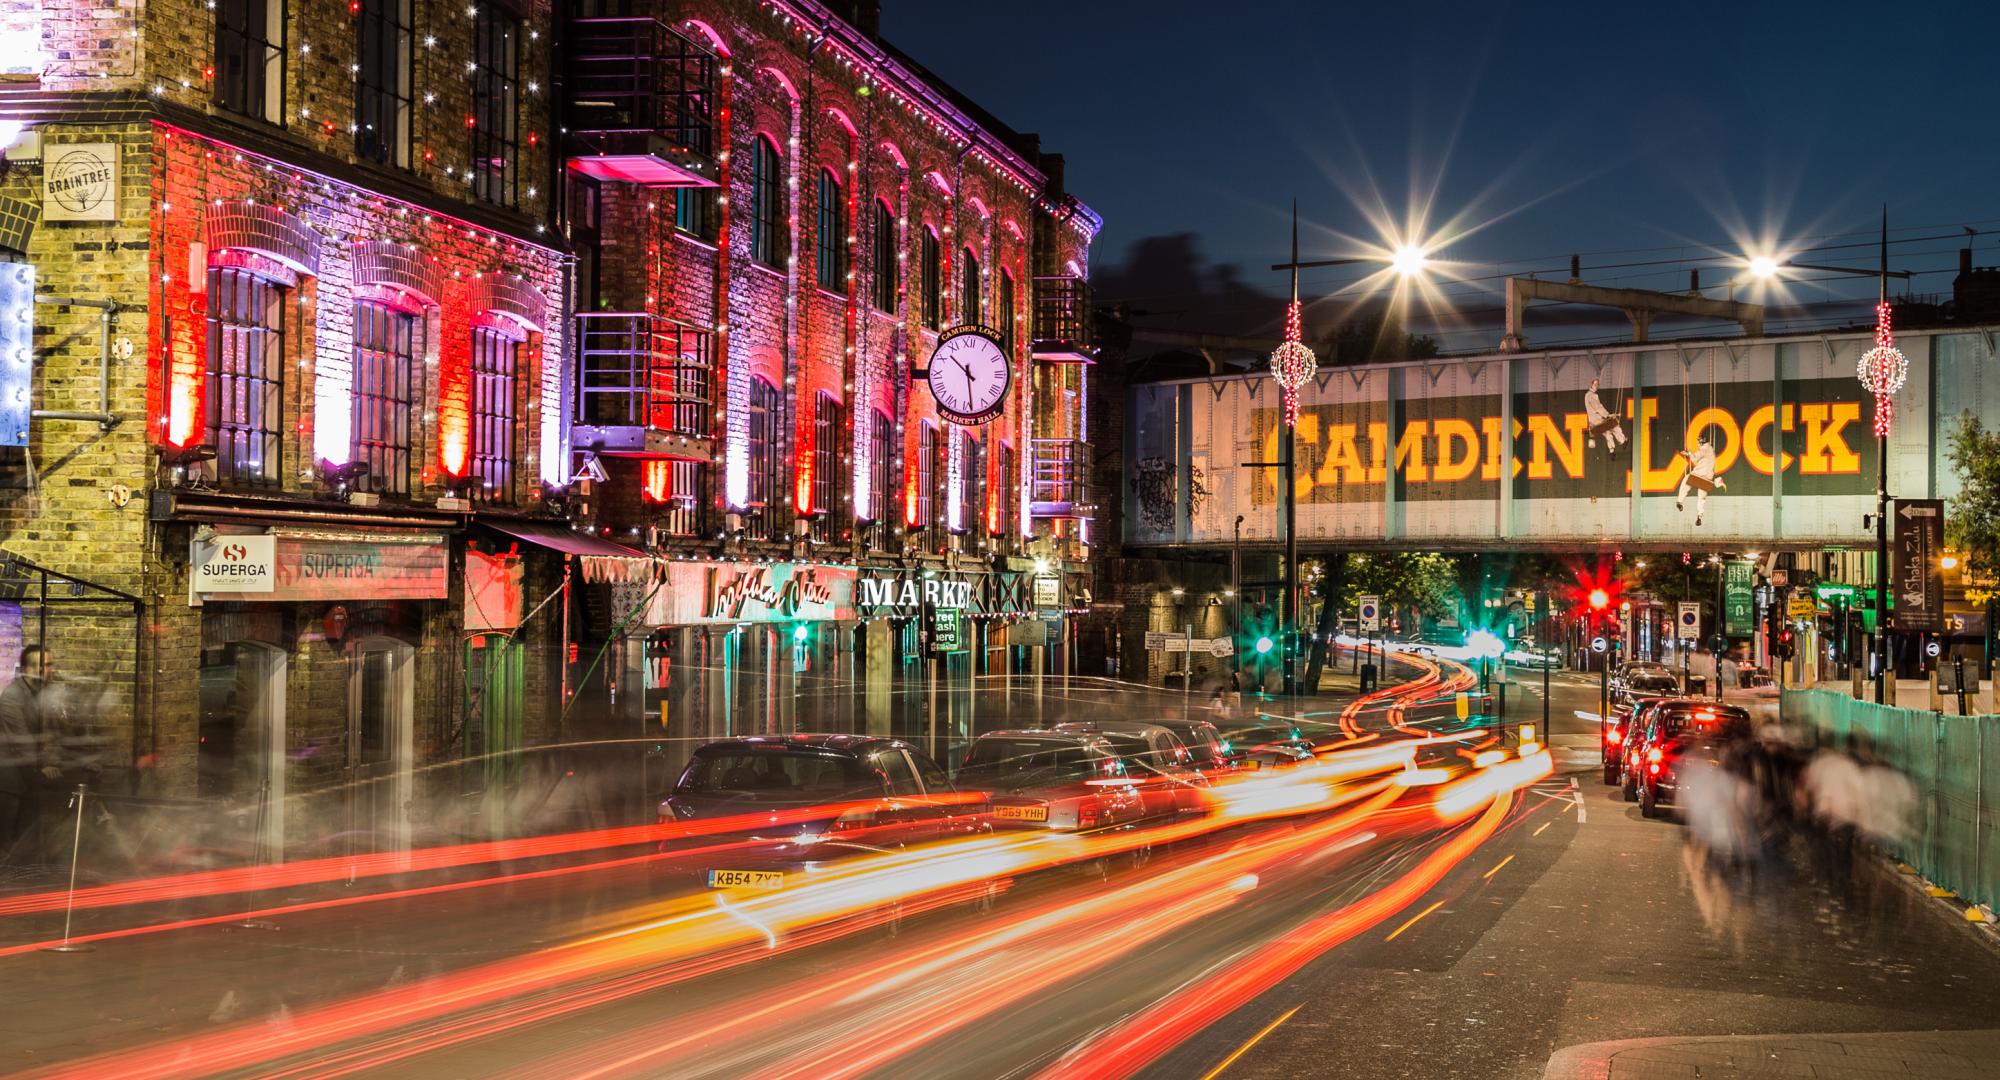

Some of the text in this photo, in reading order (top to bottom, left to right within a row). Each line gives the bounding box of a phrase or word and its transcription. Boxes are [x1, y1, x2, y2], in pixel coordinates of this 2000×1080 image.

[48, 168, 111, 194] BRAINTREE
[941, 325, 1002, 341] CAMDEN LOCK
[940, 409, 1000, 425] MARKET HALL
[1263, 412, 1589, 501] CAMDEN
[1625, 397, 1861, 494] LOCK
[1903, 525, 1921, 590] Shaka Zulu
[203, 564, 267, 577] SUPERGA
[304, 553, 374, 579] SUPERGA
[861, 578, 972, 609] MARKET
[936, 612, 954, 622] ree
[936, 621, 956, 631] ash
[1024, 808, 1044, 819] YHH
[717, 872, 751, 885] KB54
